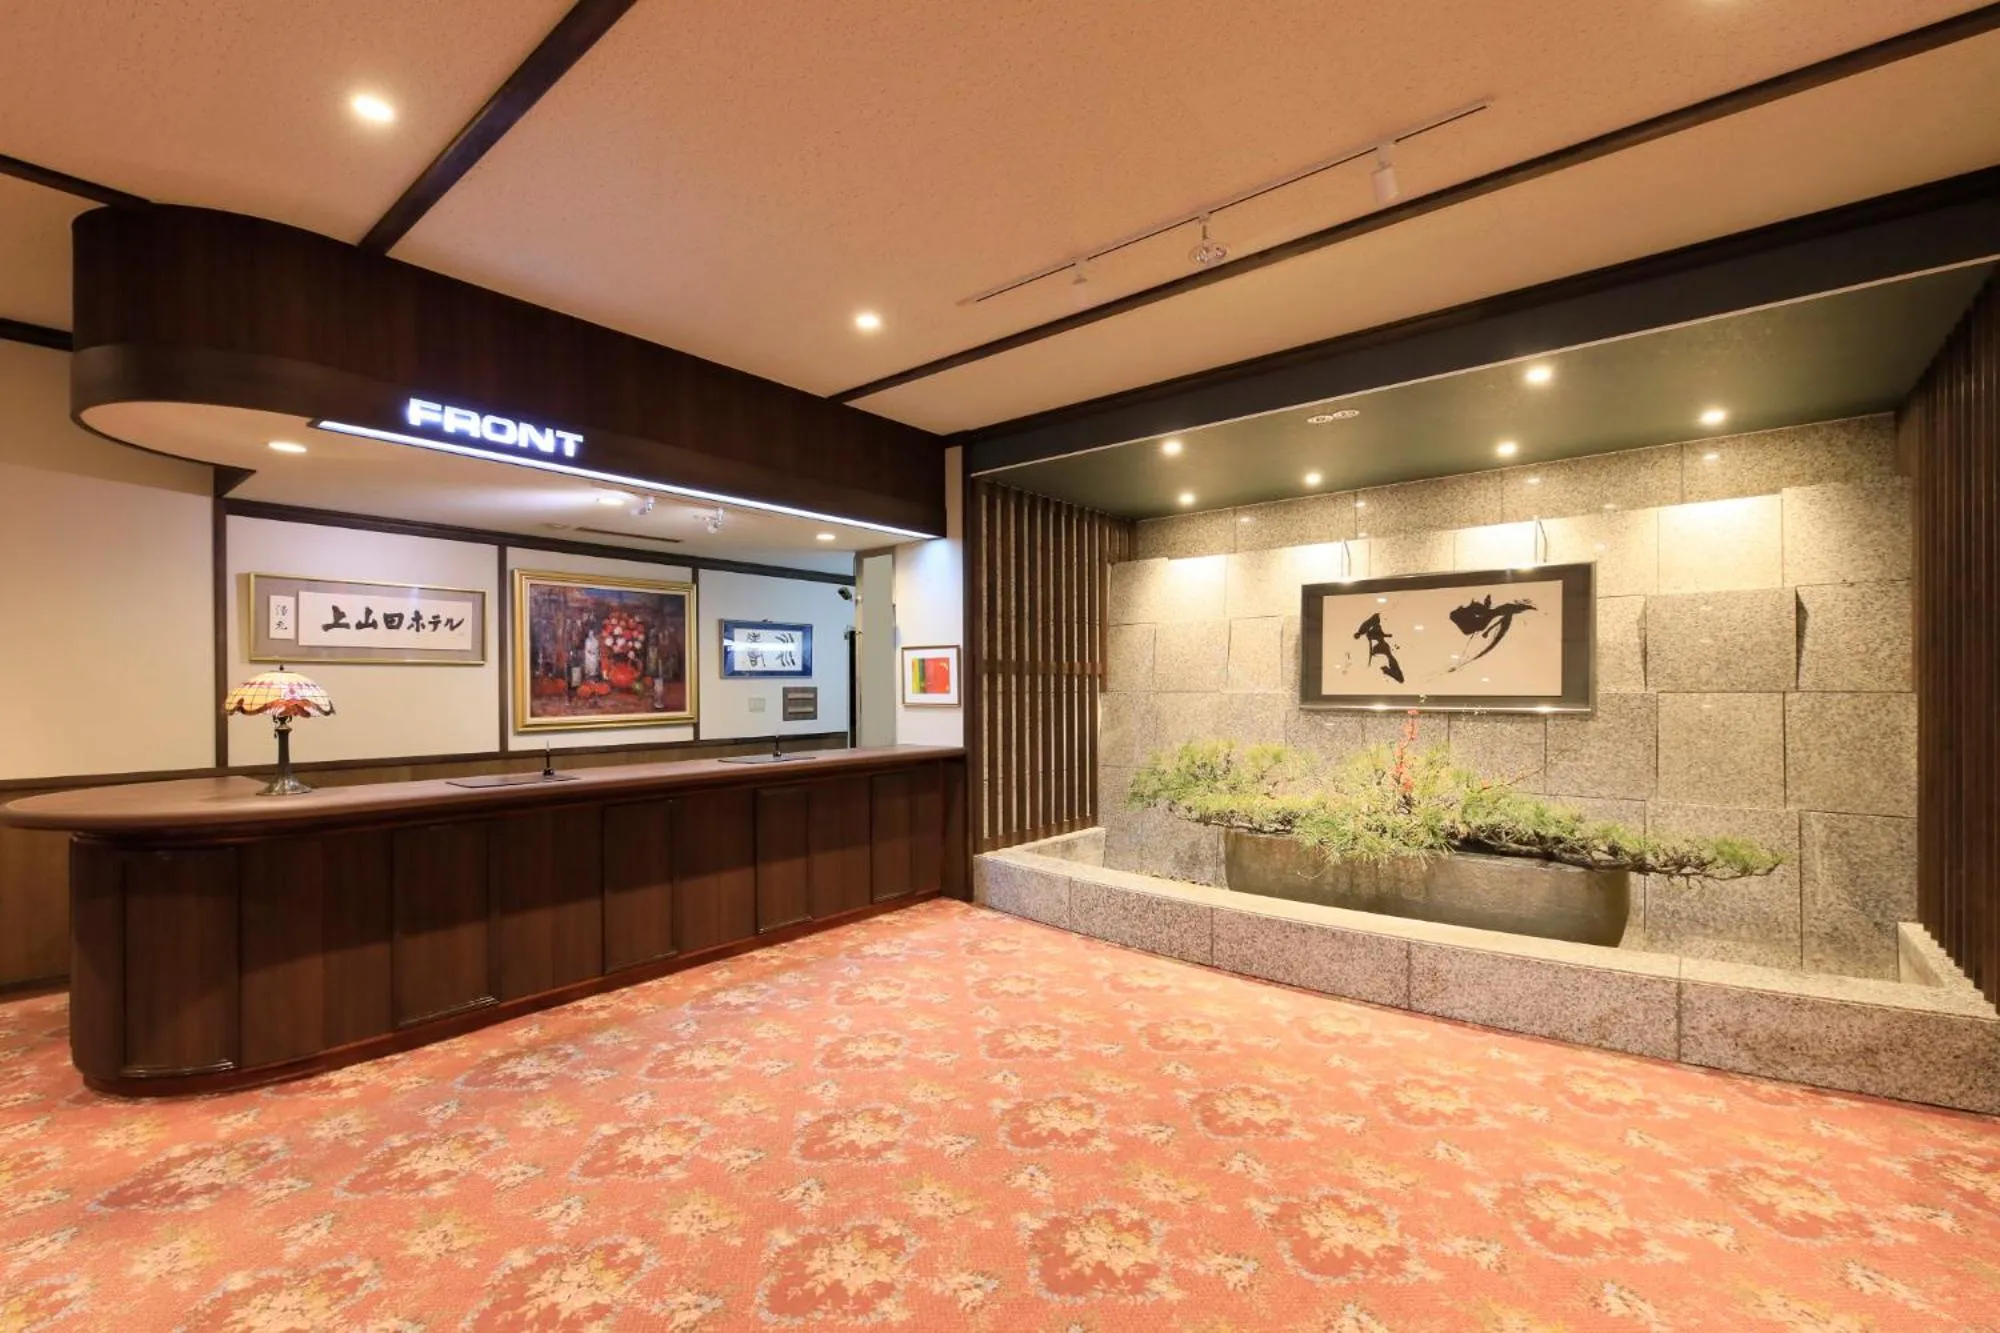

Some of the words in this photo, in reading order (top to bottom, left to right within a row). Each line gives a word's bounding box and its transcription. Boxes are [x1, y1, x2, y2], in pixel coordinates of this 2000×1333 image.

[408, 397, 584, 458] FRONT
[322, 605, 465, 632] 上山田ホテル
